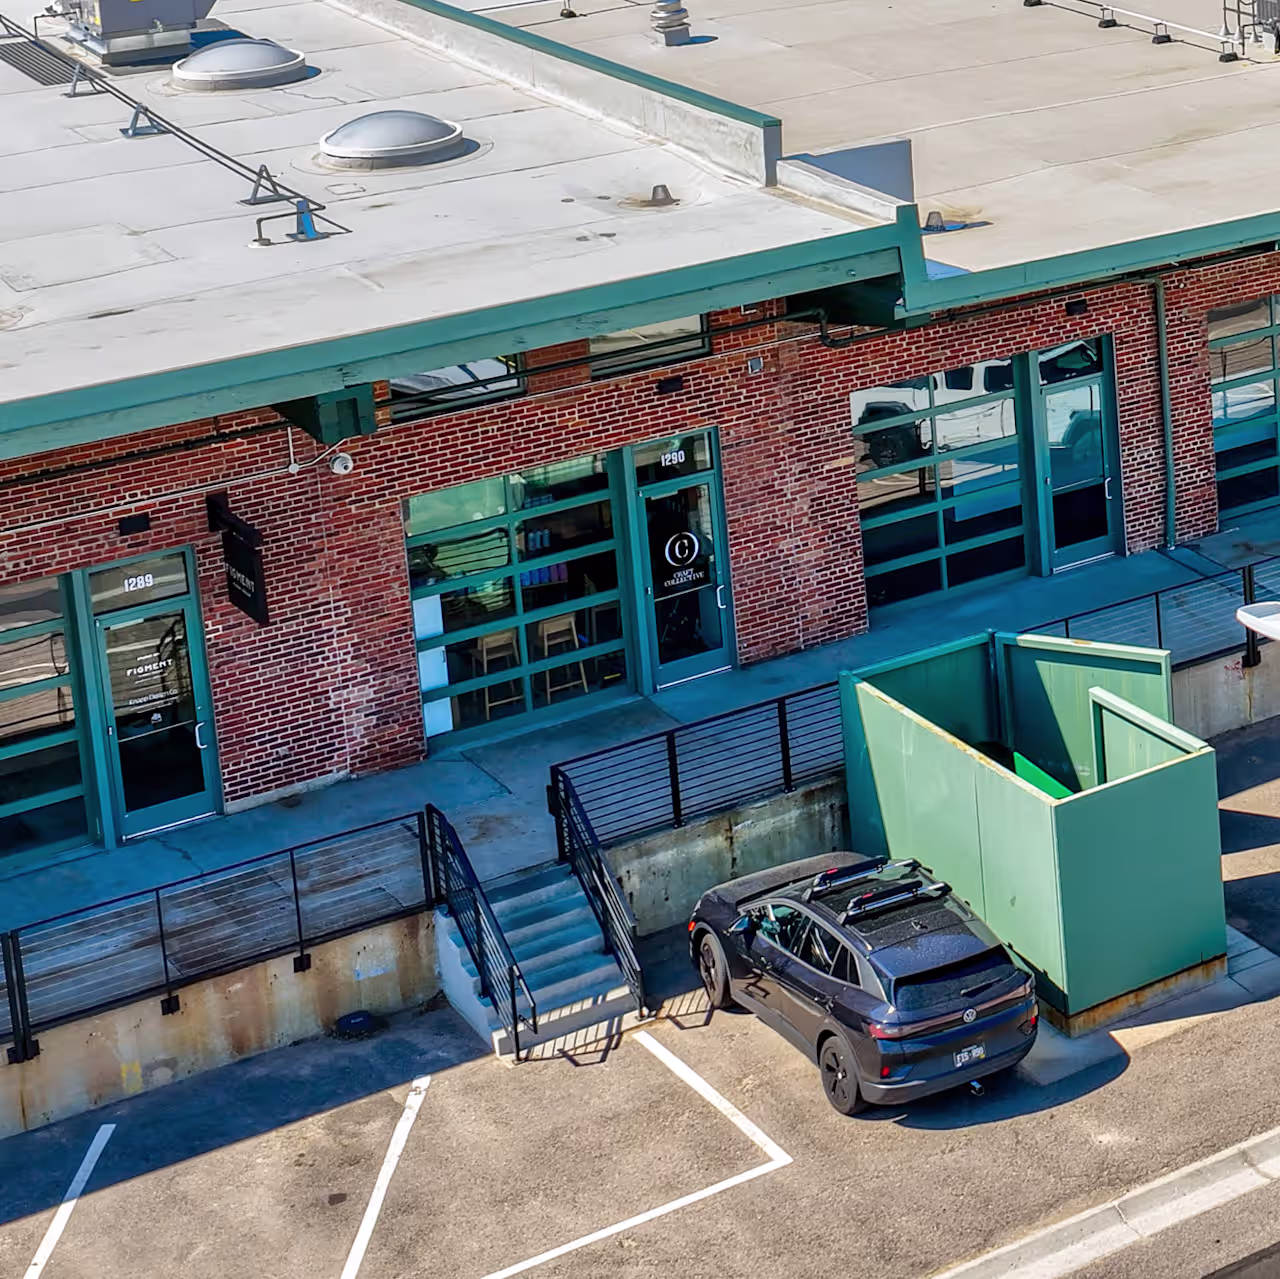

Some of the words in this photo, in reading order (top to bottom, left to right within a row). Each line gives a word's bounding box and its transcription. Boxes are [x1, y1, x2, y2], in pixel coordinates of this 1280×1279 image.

[661, 450, 685, 466] 1290
[664, 571, 704, 587] COLLECTIVE
[673, 568, 694, 579] CRAFT
[124, 573, 153, 592] 1289
[126, 658, 173, 677] FIGMENT
